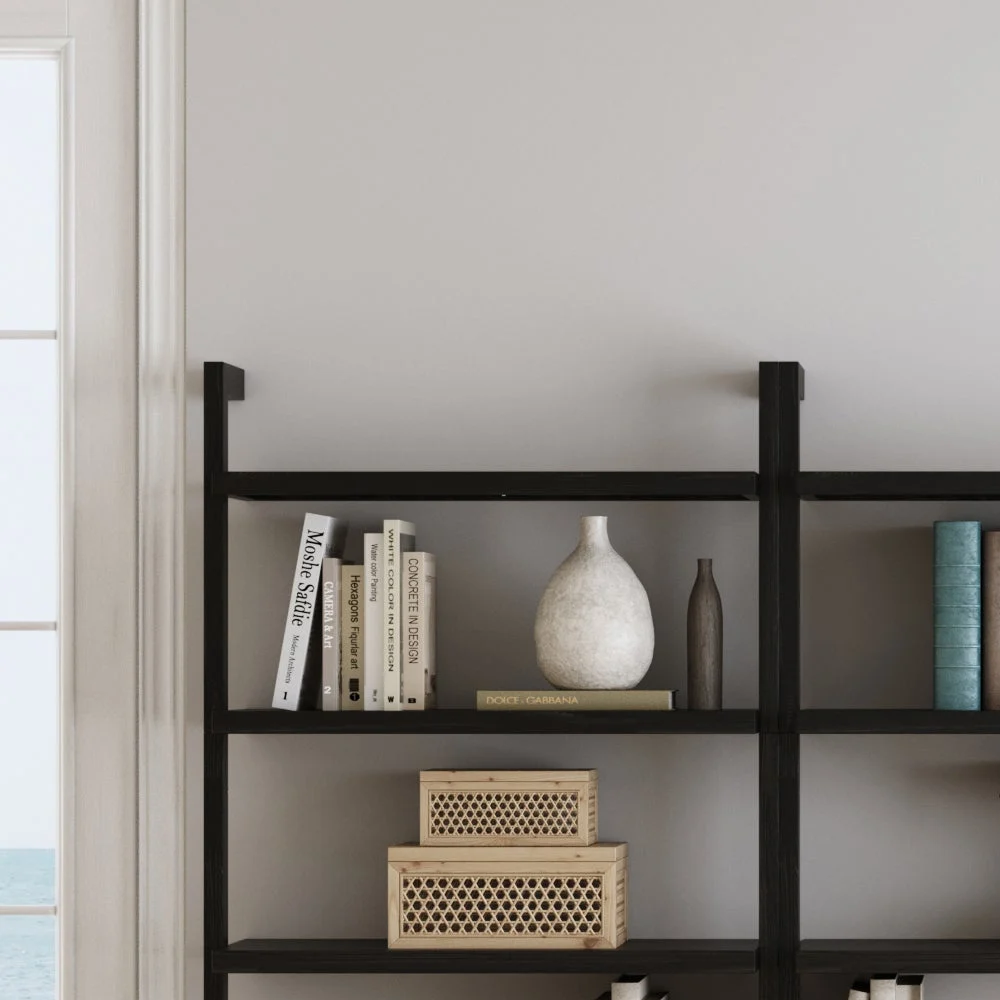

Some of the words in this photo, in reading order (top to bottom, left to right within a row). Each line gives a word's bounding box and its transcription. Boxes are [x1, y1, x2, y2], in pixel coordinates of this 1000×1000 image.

[300, 529, 325, 579] Moshe
[370, 543, 379, 561] Water
[370, 562, 379, 578] color
[369, 578, 379, 602] Painting
[387, 569, 395, 610] COLOR
[408, 558, 419, 613] CONCRETE
[291, 582, 315, 627] Safdie
[324, 581, 334, 622] CAMERA
[348, 574, 361, 623] Hexagons
[324, 624, 334, 633] &
[388, 613, 395, 625] IN
[408, 615, 419, 625] IN
[324, 634, 334, 649] Art
[387, 628, 395, 672] DESIGN
[408, 627, 419, 665] DESIGN
[350, 658, 360, 671] art
[324, 685, 332, 695] 2
[486, 696, 520, 705] DOLCE
[526, 696, 579, 705] GABBANA
